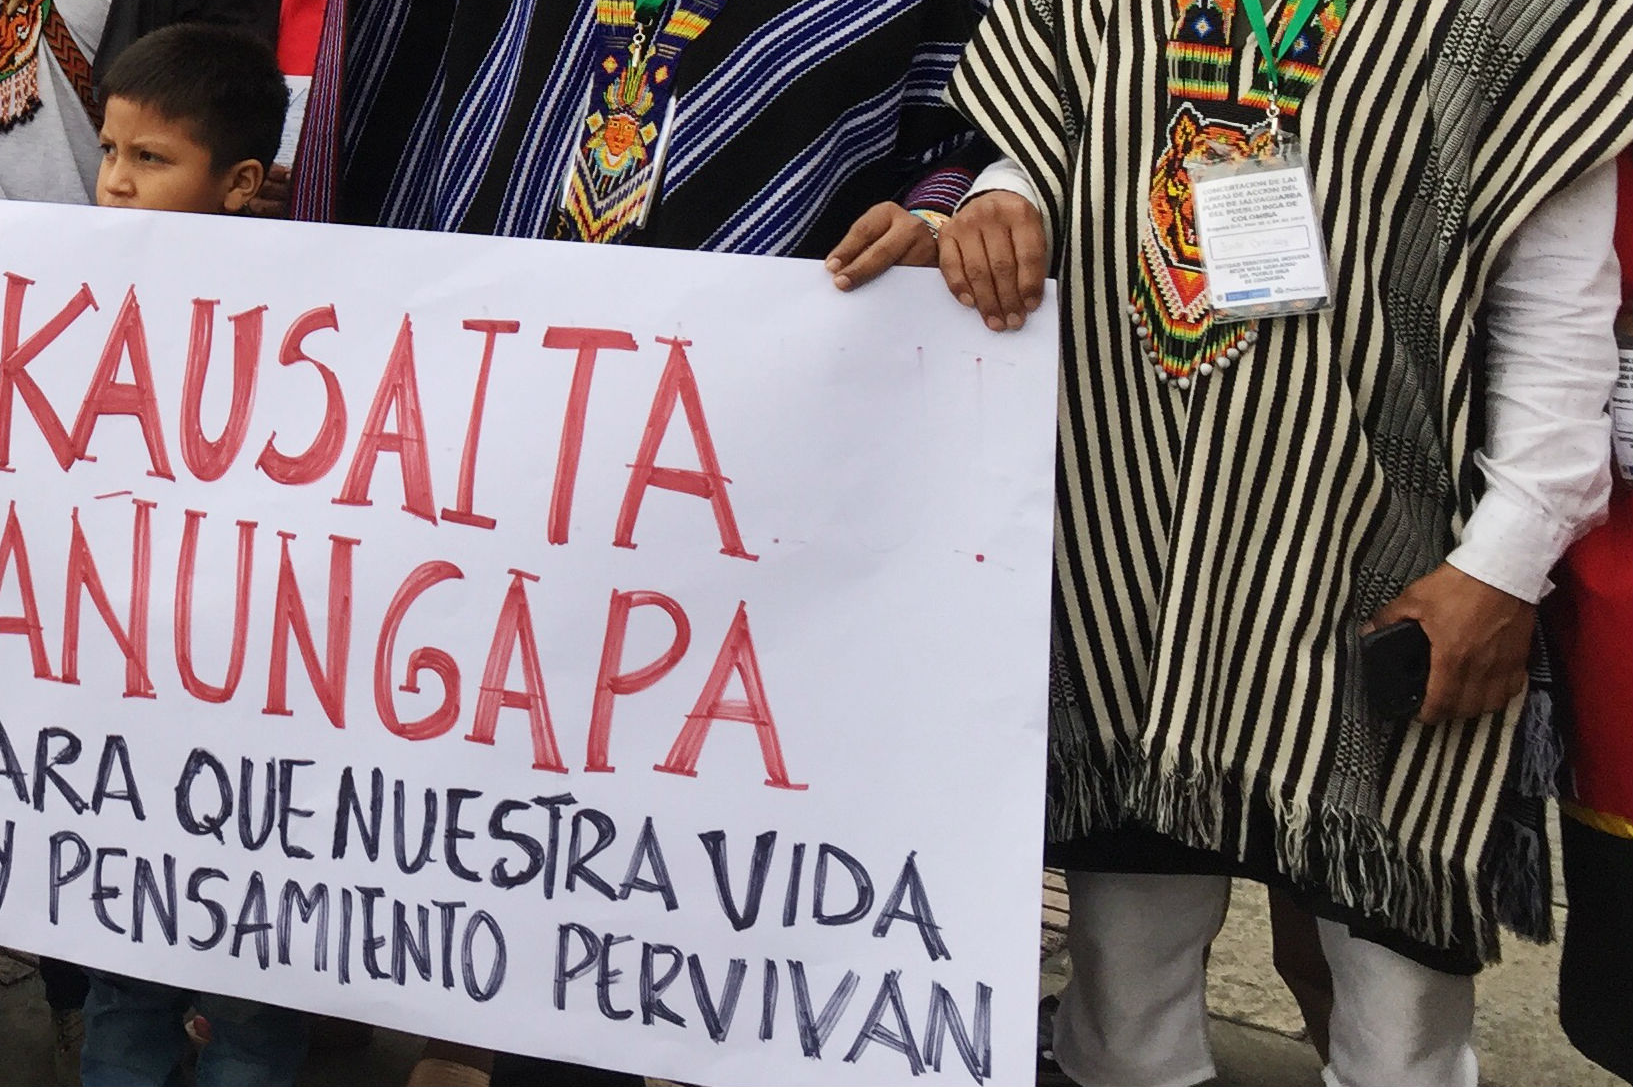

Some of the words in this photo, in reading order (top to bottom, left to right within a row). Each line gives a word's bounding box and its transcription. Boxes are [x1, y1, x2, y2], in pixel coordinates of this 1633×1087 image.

[50, 830, 507, 1004] PENSAMIENTO
[555, 921, 993, 1086] PERVIVAN
[174, 747, 316, 861] QUE
[331, 765, 679, 913] NUESTRA
[698, 828, 952, 963] VIDA
